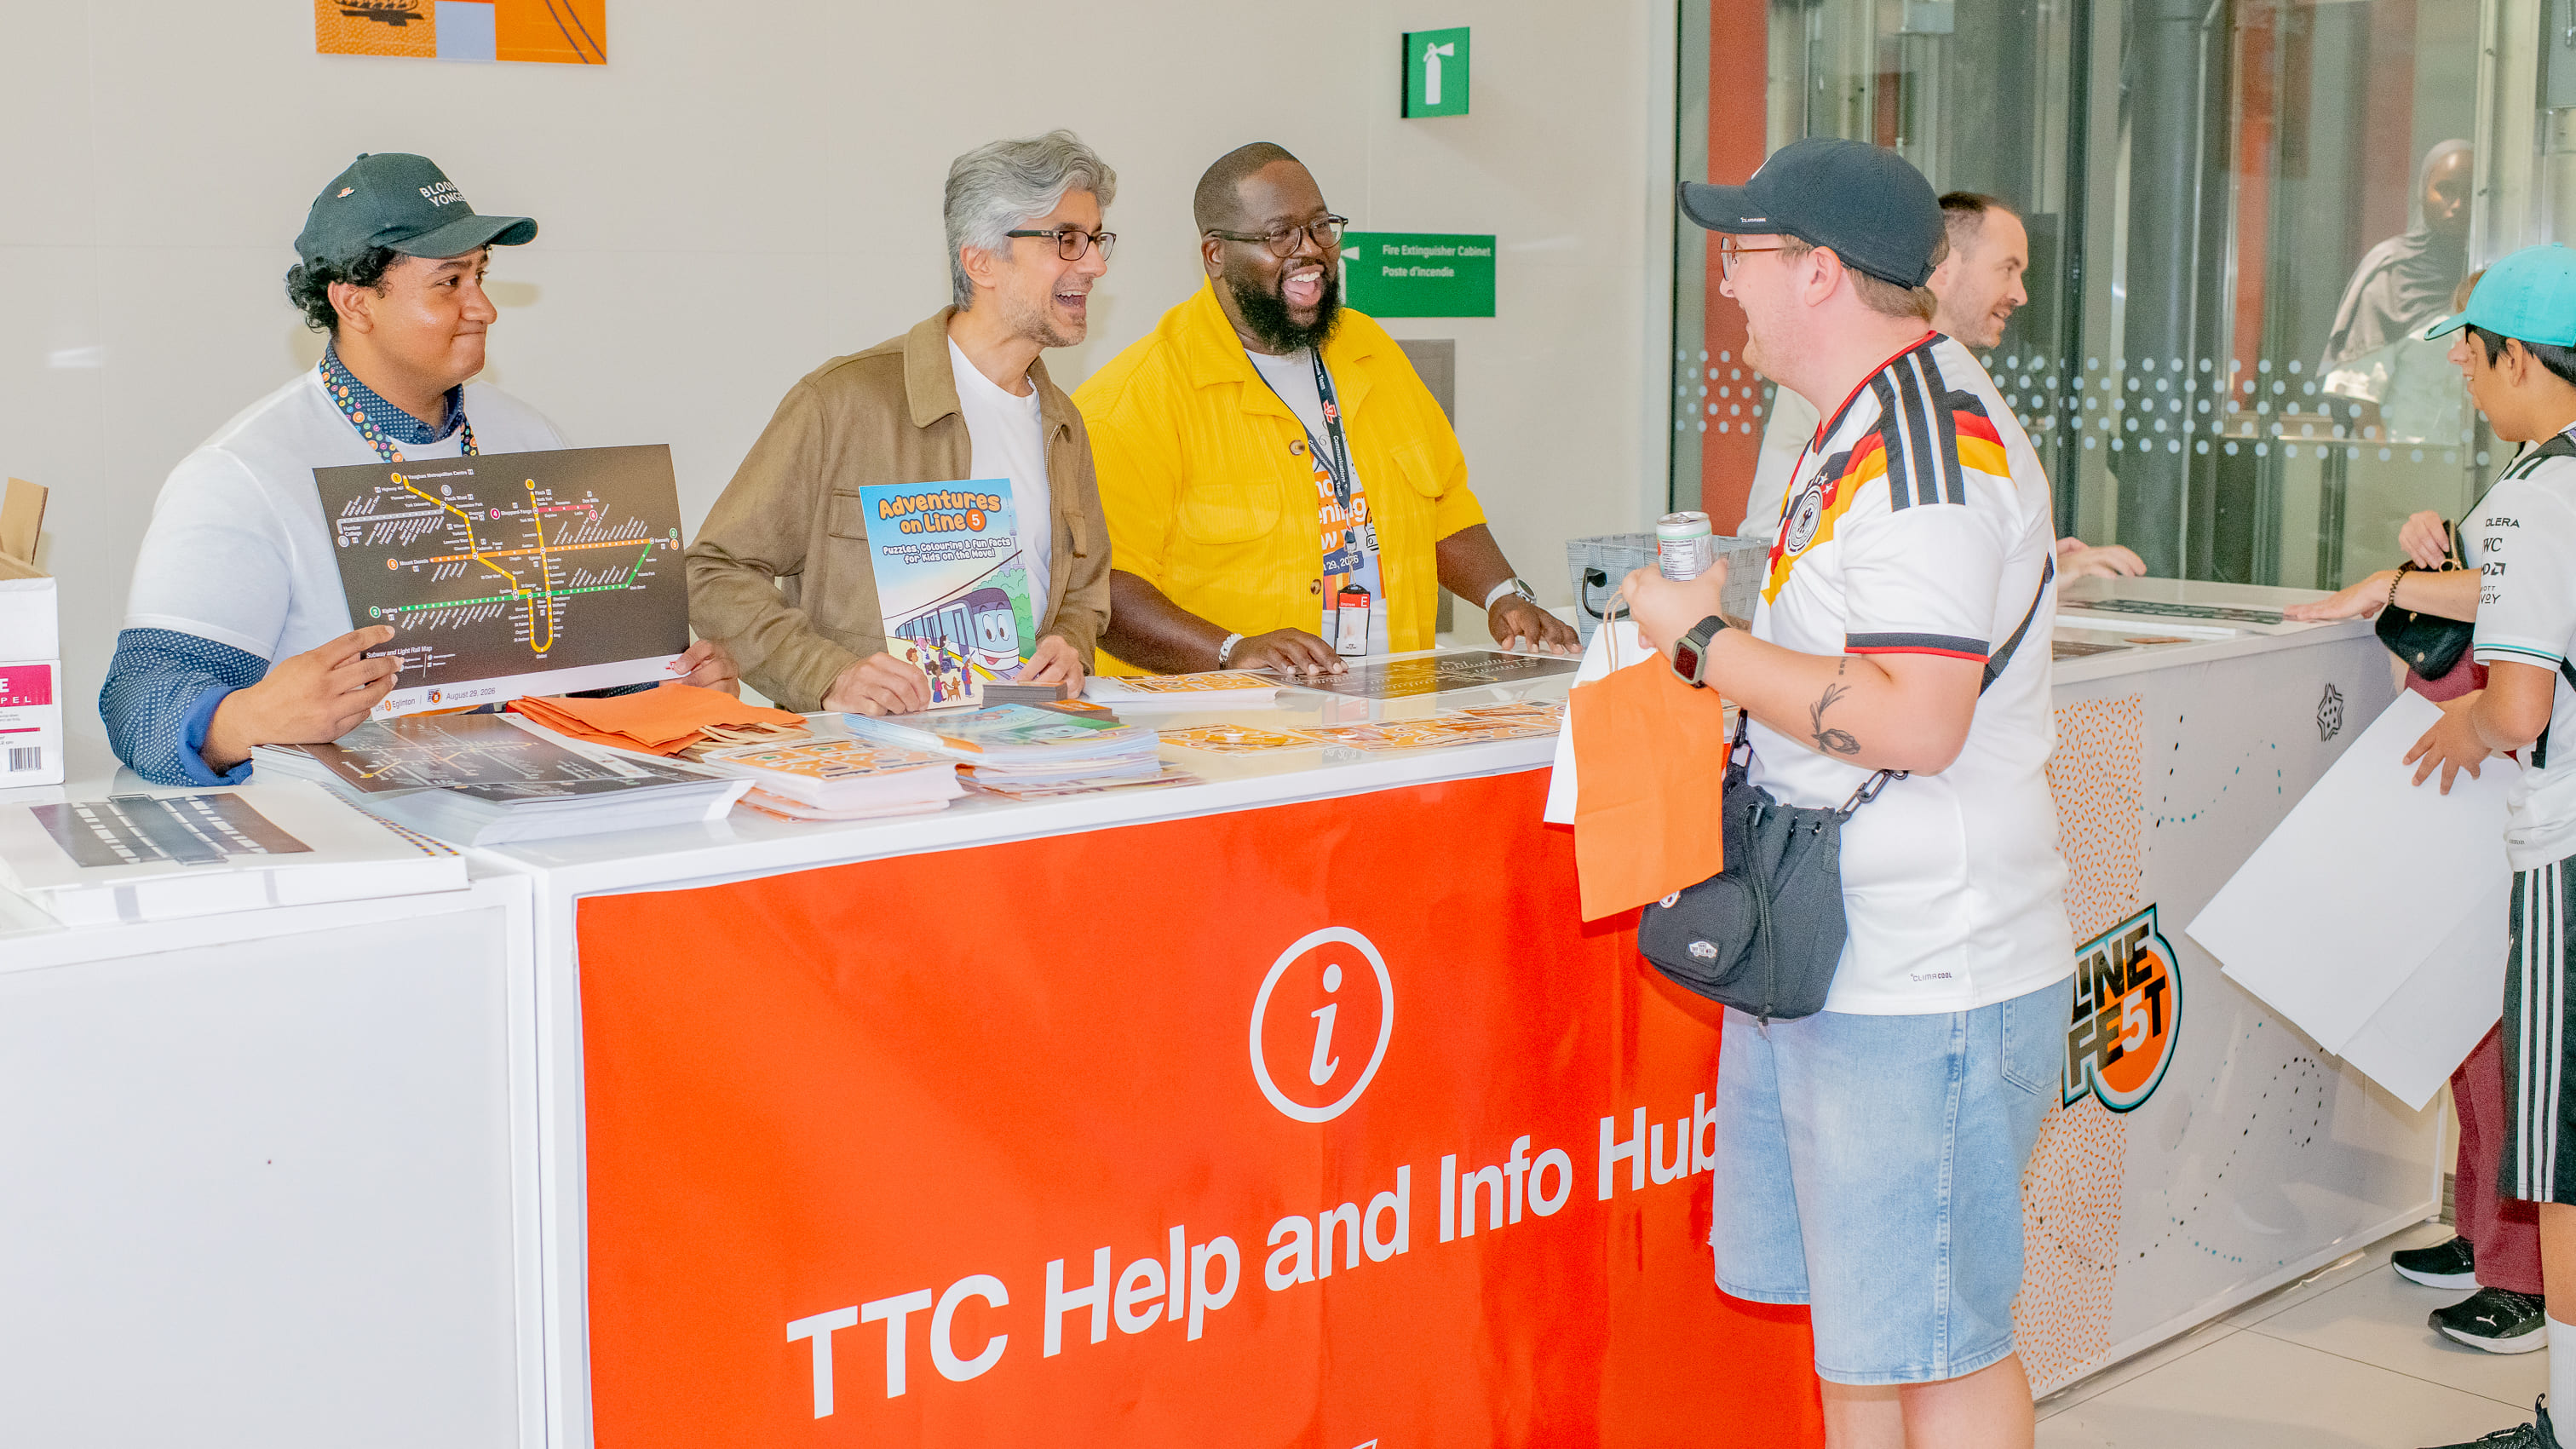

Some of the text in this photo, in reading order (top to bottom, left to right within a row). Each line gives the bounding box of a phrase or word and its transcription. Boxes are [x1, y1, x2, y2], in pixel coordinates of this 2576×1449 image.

[1383, 245, 1491, 258] Fire Extinguisher Cabinet
[1383, 267, 1454, 277] Poste d'incendie
[879, 490, 1001, 520] Adventures
[900, 512, 980, 533] on Line 5
[883, 544, 920, 555] Puzzles,
[921, 541, 963, 553] Colouring
[964, 540, 971, 549] &
[904, 549, 996, 564] for Kids on the Move!
[1361, 596, 1367, 607] E
[366, 649, 387, 658] Subway
[397, 647, 411, 656] Light
[480, 687, 496, 696] 2026
[393, 699, 416, 709] Eglinton
[2071, 922, 2152, 1026] LINE
[2068, 975, 2165, 1089] FE5T
[787, 1093, 1719, 1418] TTC Help and Info Hub
